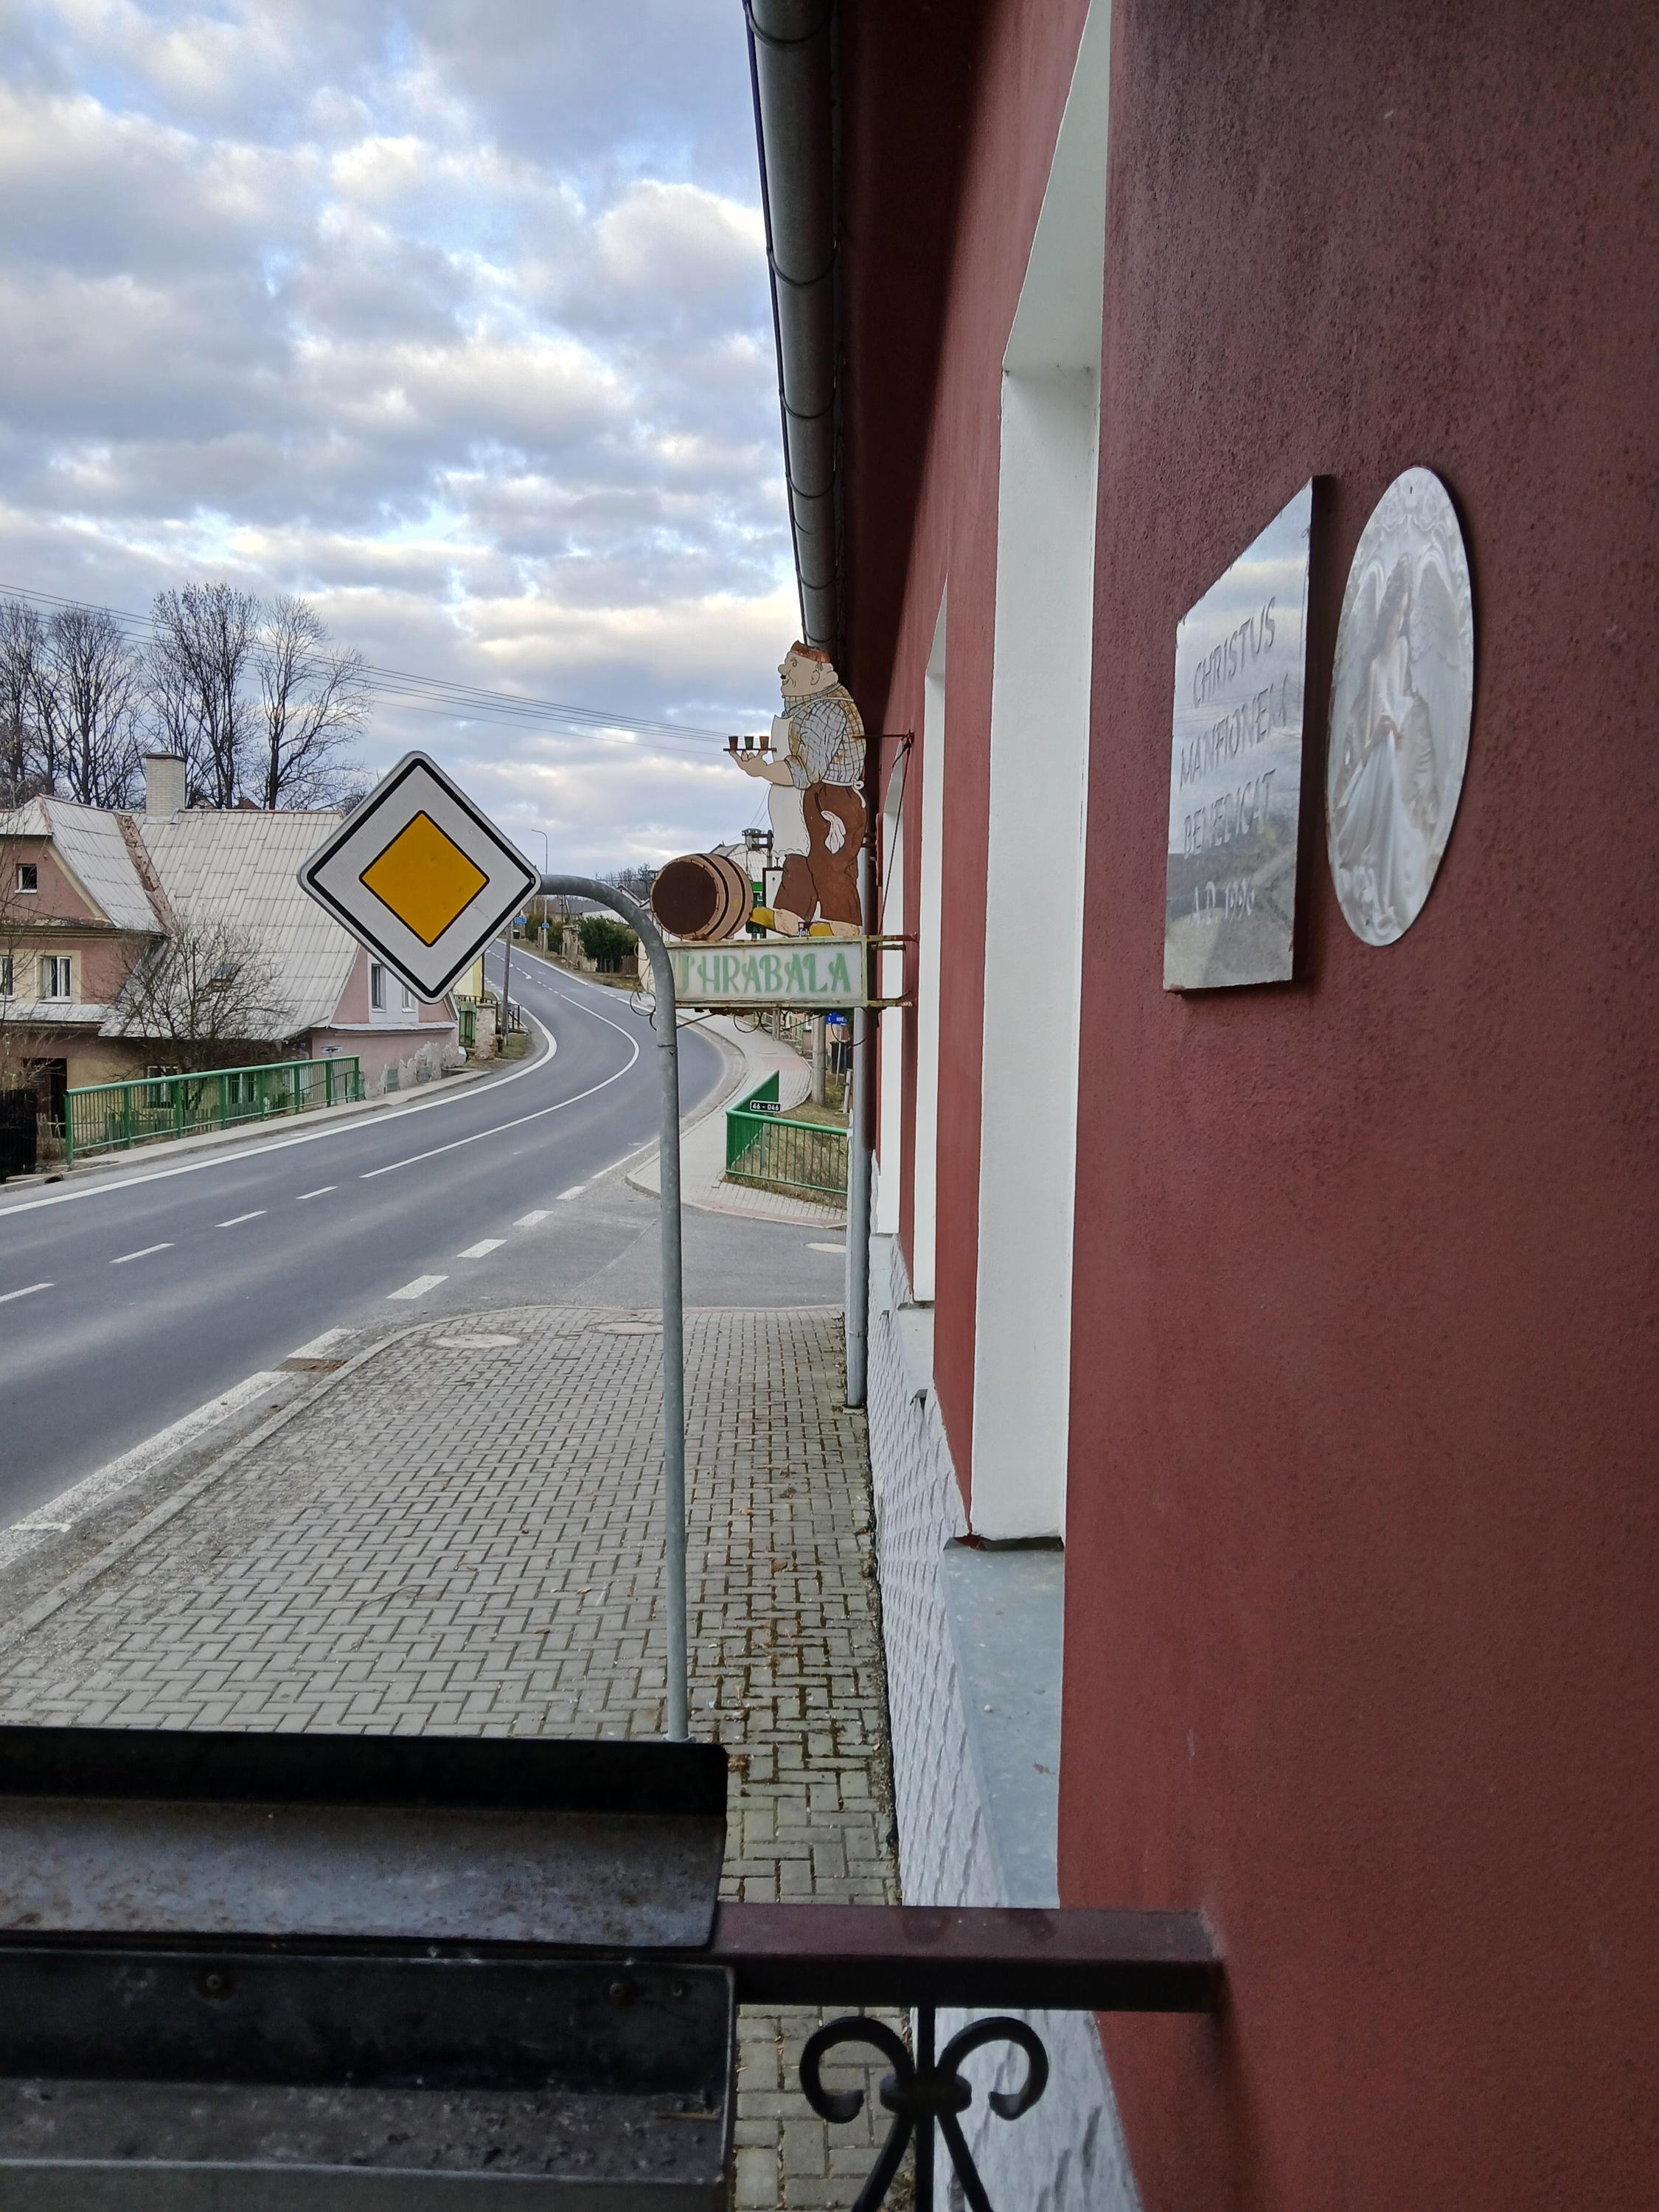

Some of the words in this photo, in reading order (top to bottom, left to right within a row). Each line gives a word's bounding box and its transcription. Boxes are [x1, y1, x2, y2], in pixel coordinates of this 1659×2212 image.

[1192, 595, 1277, 709] CHRISTUS
[1183, 768, 1276, 860] BENEDICAT
[697, 952, 852, 994] HRABALA
